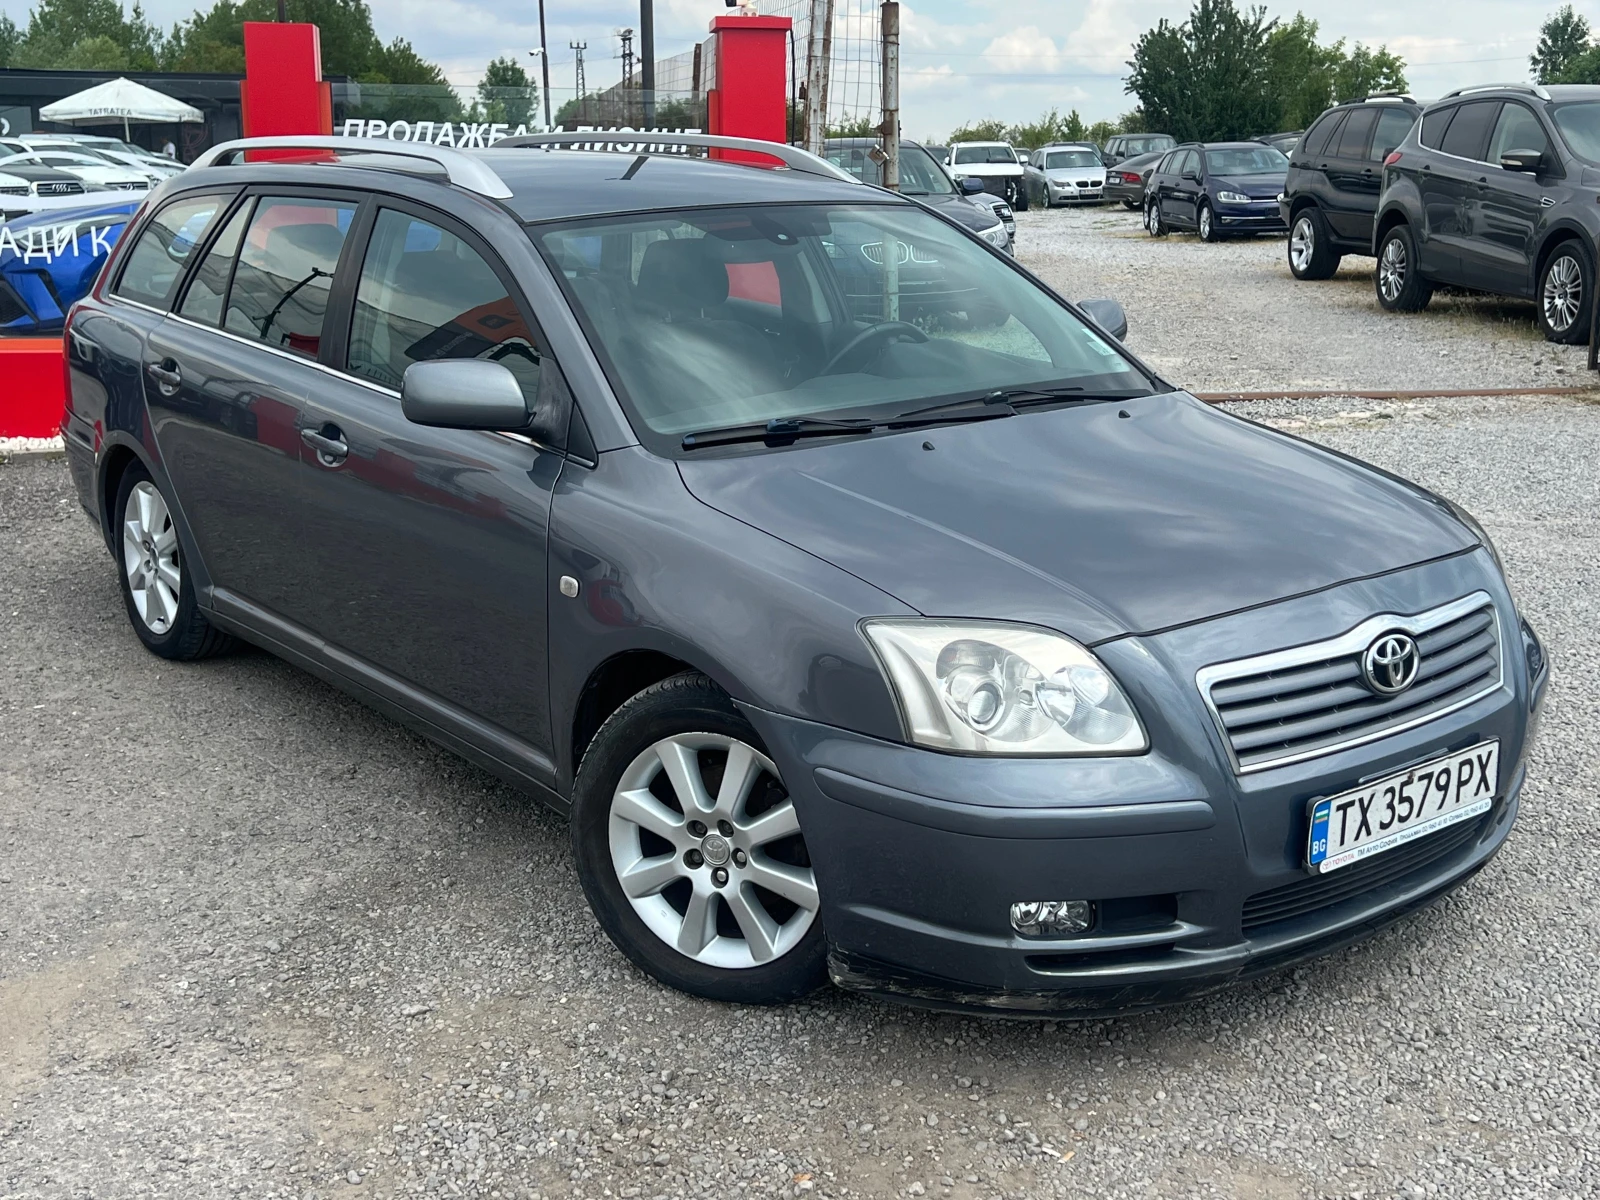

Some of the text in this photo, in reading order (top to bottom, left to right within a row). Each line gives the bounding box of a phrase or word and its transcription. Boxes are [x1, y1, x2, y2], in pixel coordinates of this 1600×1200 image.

[88, 107, 132, 116] TATRATEA
[1312, 838, 1326, 855] BG
[1332, 853, 1355, 865] TOYOTA
